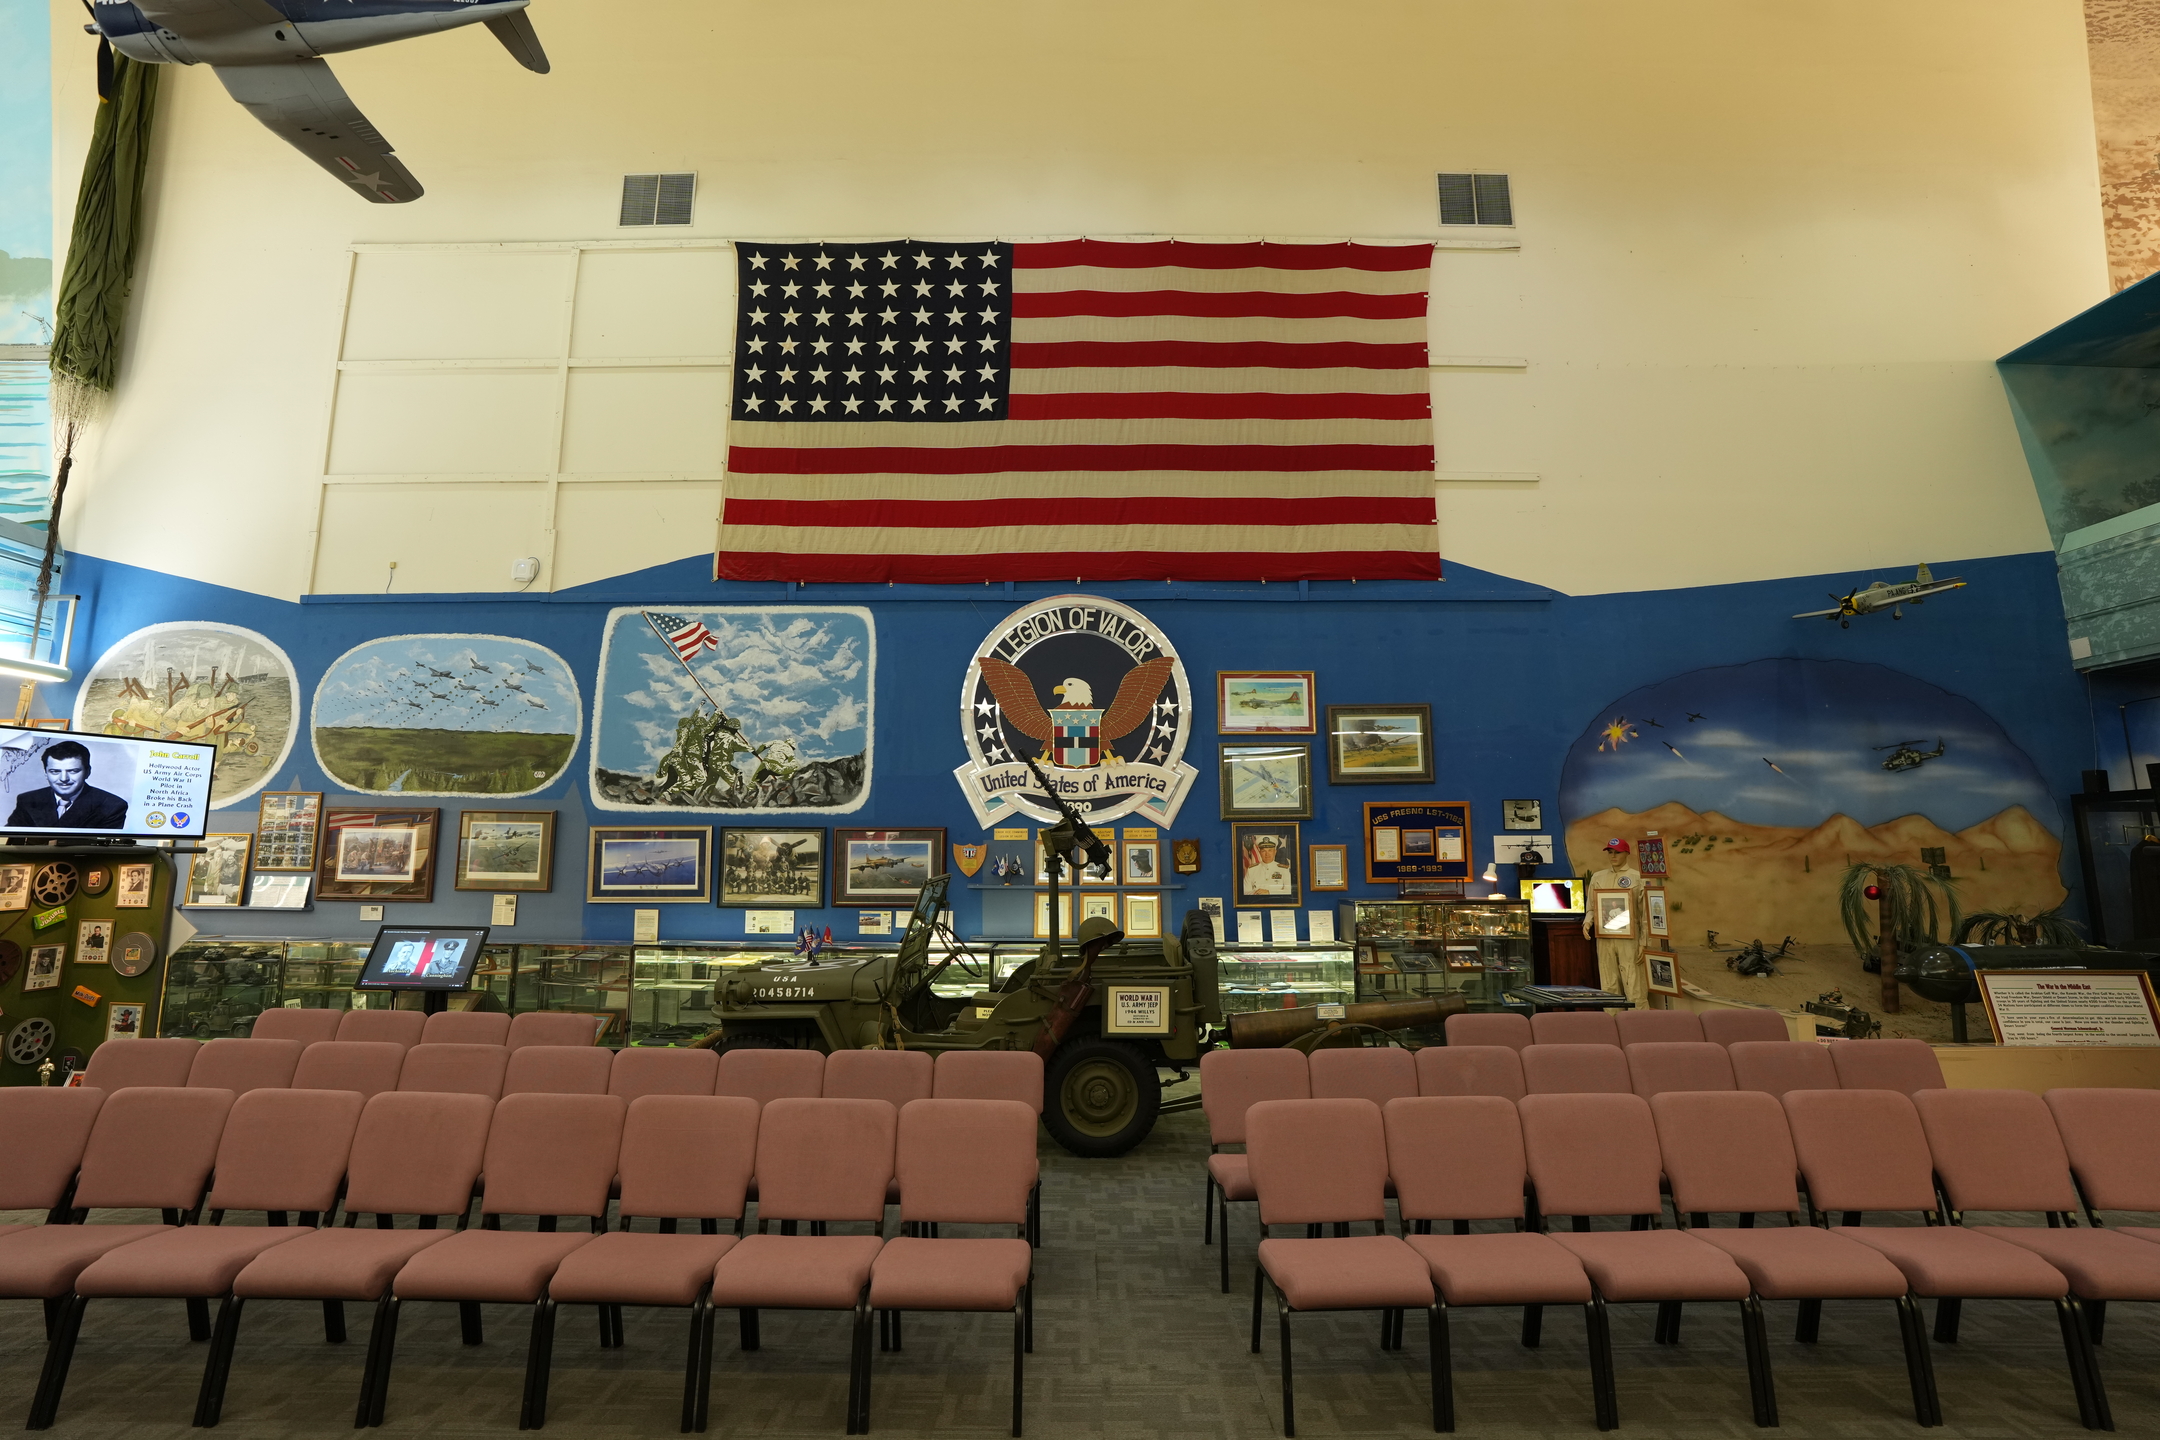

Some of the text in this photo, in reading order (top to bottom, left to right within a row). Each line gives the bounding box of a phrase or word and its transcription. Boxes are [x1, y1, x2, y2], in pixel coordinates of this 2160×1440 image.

[995, 608, 1153, 662] LEGION OF VALOR
[150, 750, 200, 760] John Carroll
[980, 770, 1028, 793] United
[1083, 774, 1100, 793] of
[1105, 772, 1167, 793] America
[1064, 802, 1092, 814] 890
[1372, 808, 1464, 825] USS FRESNO LST-1182
[752, 987, 815, 998] 20458714
